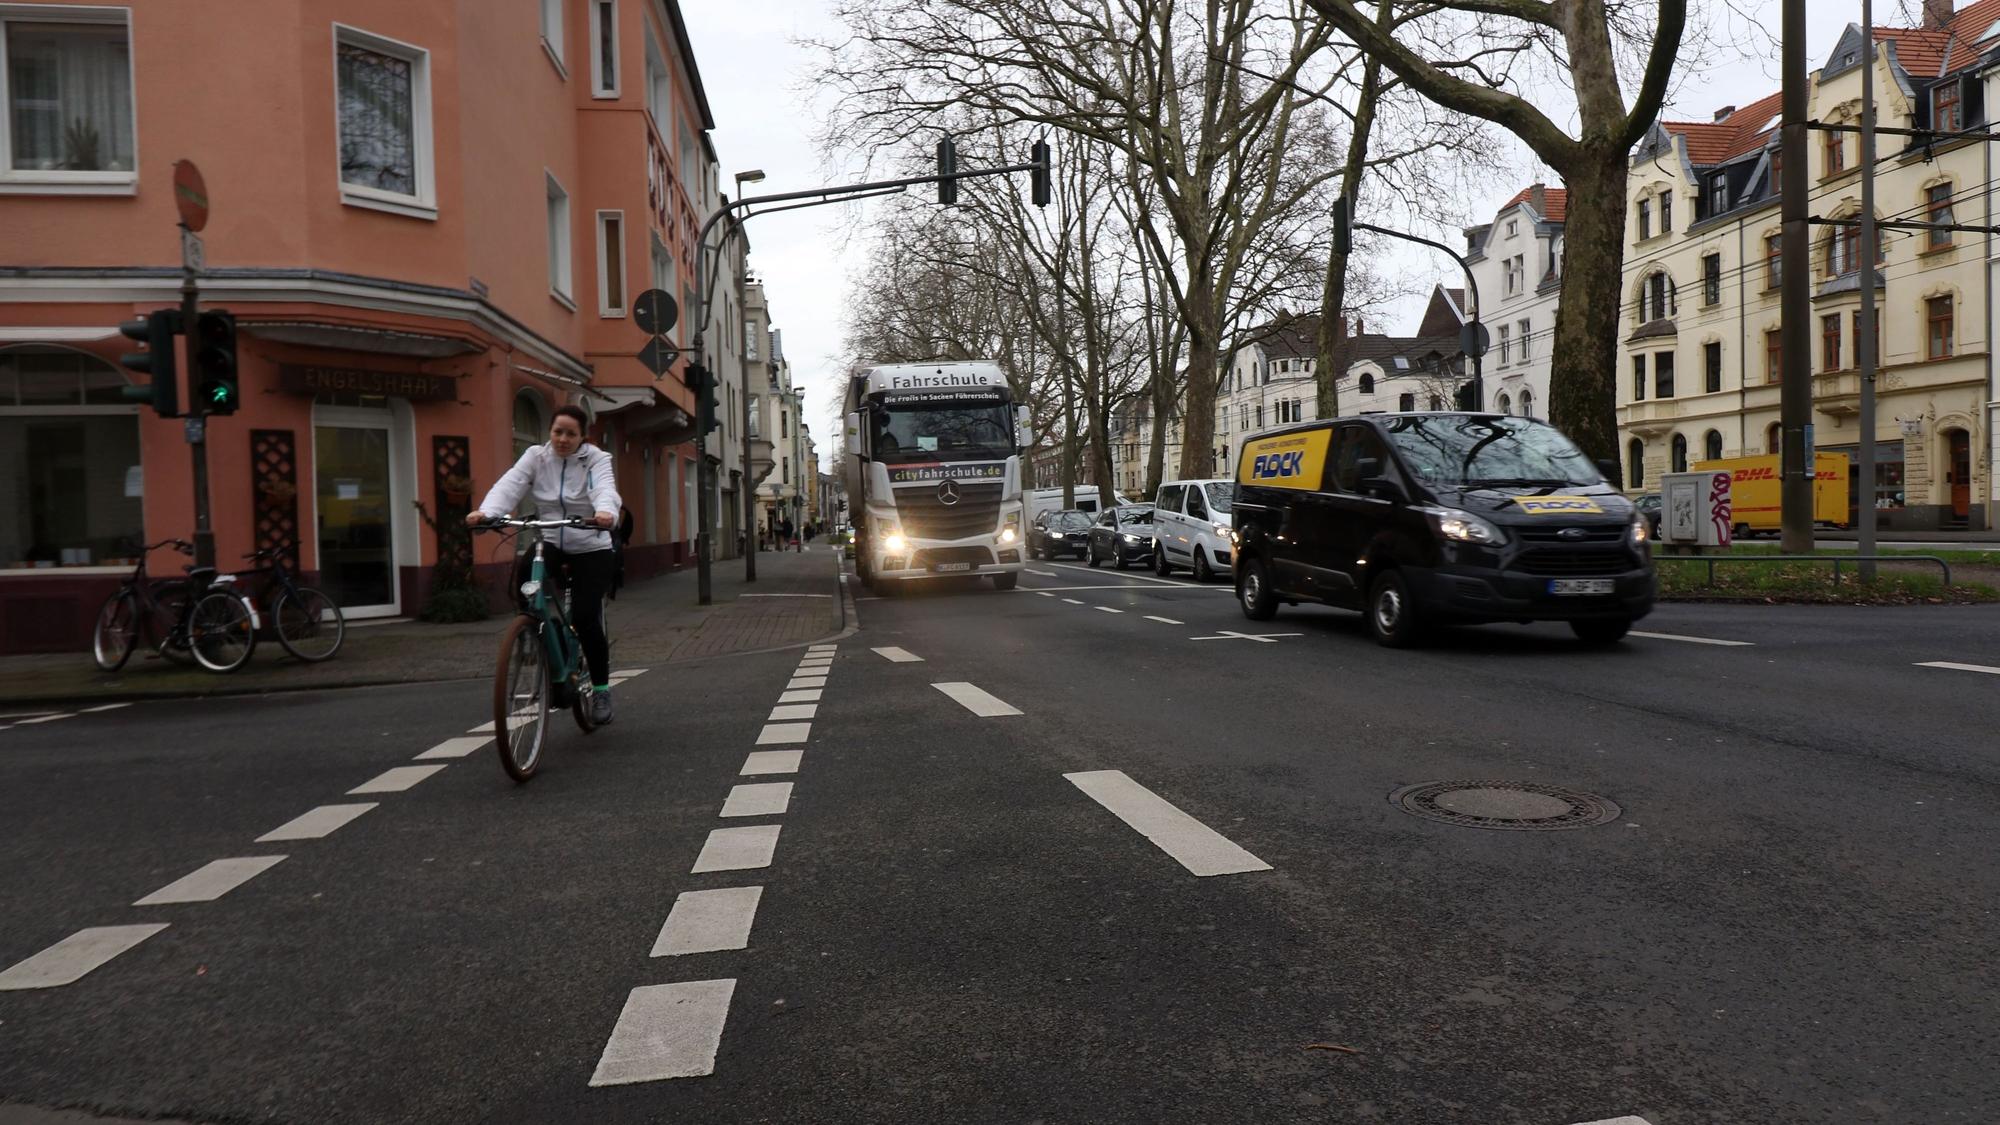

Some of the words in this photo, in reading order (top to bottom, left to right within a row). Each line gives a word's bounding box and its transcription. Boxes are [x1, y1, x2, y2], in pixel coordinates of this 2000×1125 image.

[892, 373, 988, 389] Fahrschule
[1252, 451, 1304, 479] FLOCK
[894, 465, 1001, 482] cityfahrschule.de
[1734, 467, 1775, 482] DHL
